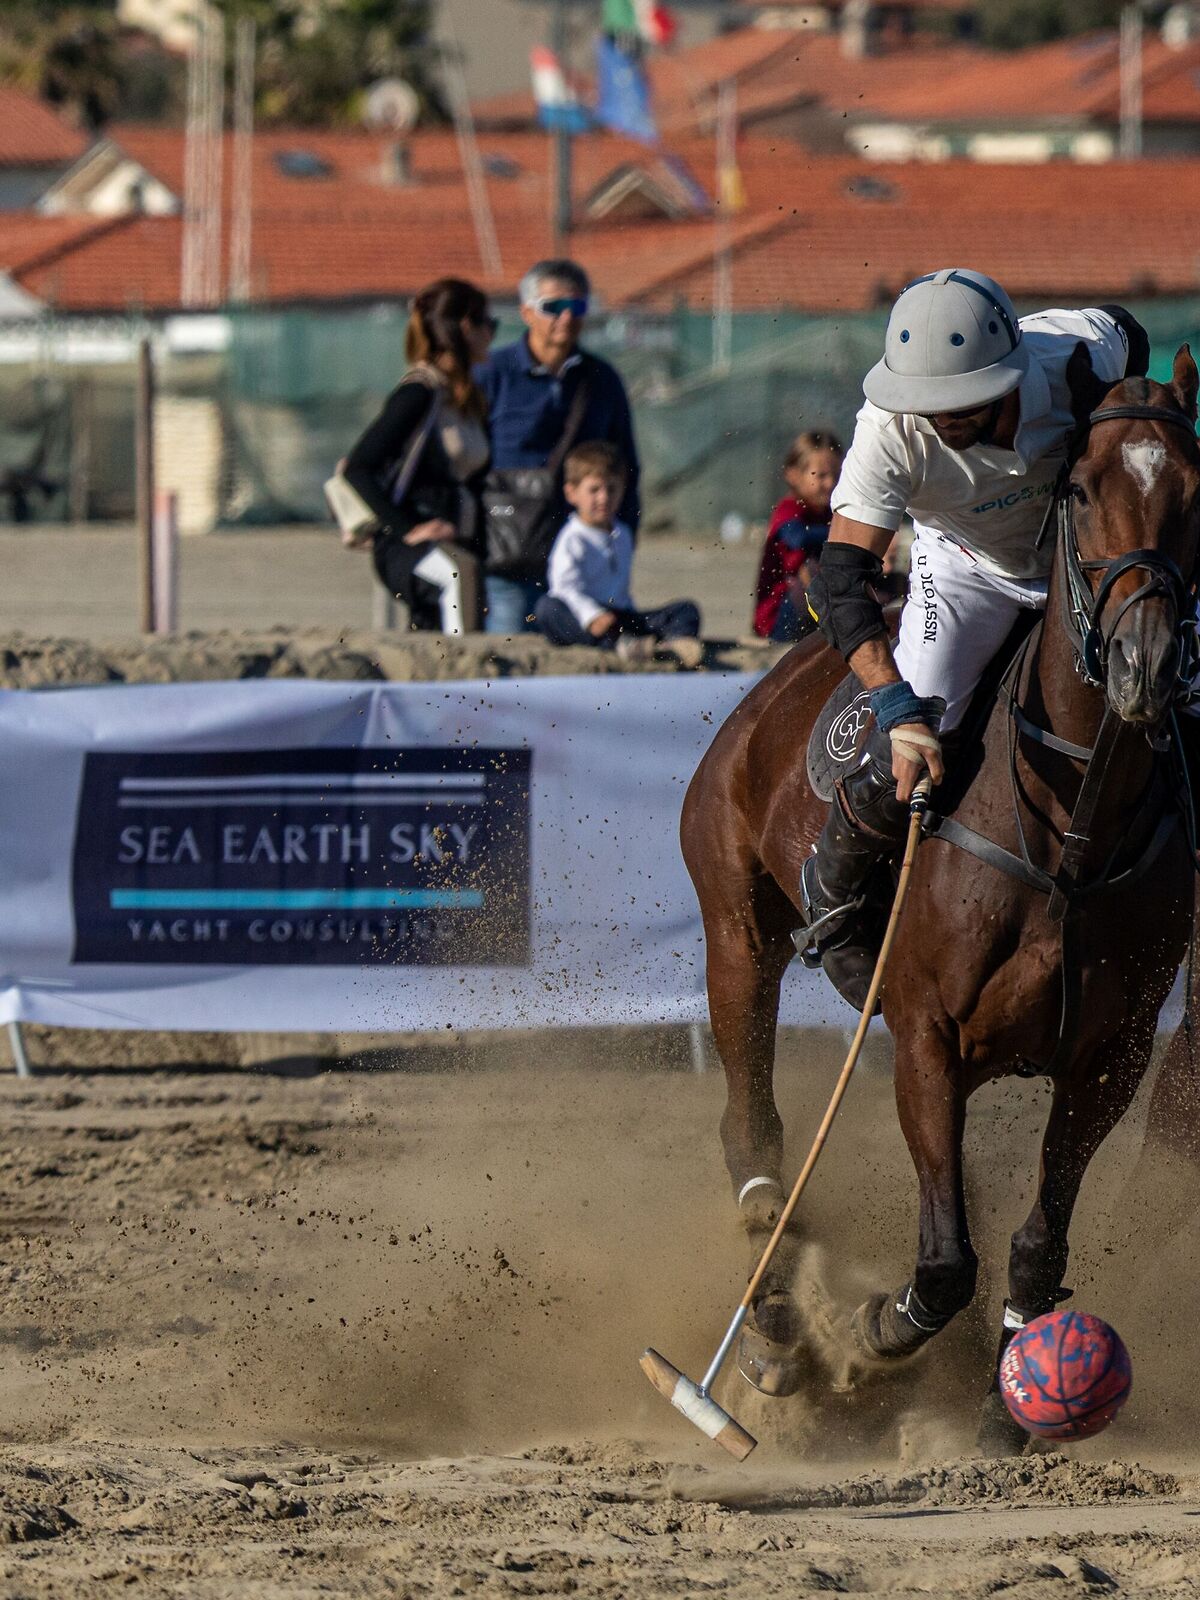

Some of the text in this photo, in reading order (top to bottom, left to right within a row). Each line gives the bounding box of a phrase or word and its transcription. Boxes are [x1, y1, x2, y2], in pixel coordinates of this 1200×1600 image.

[923, 600, 938, 645] ASSN.
[117, 822, 479, 864] SEA EARTH SKY
[126, 918, 232, 943] YACHT
